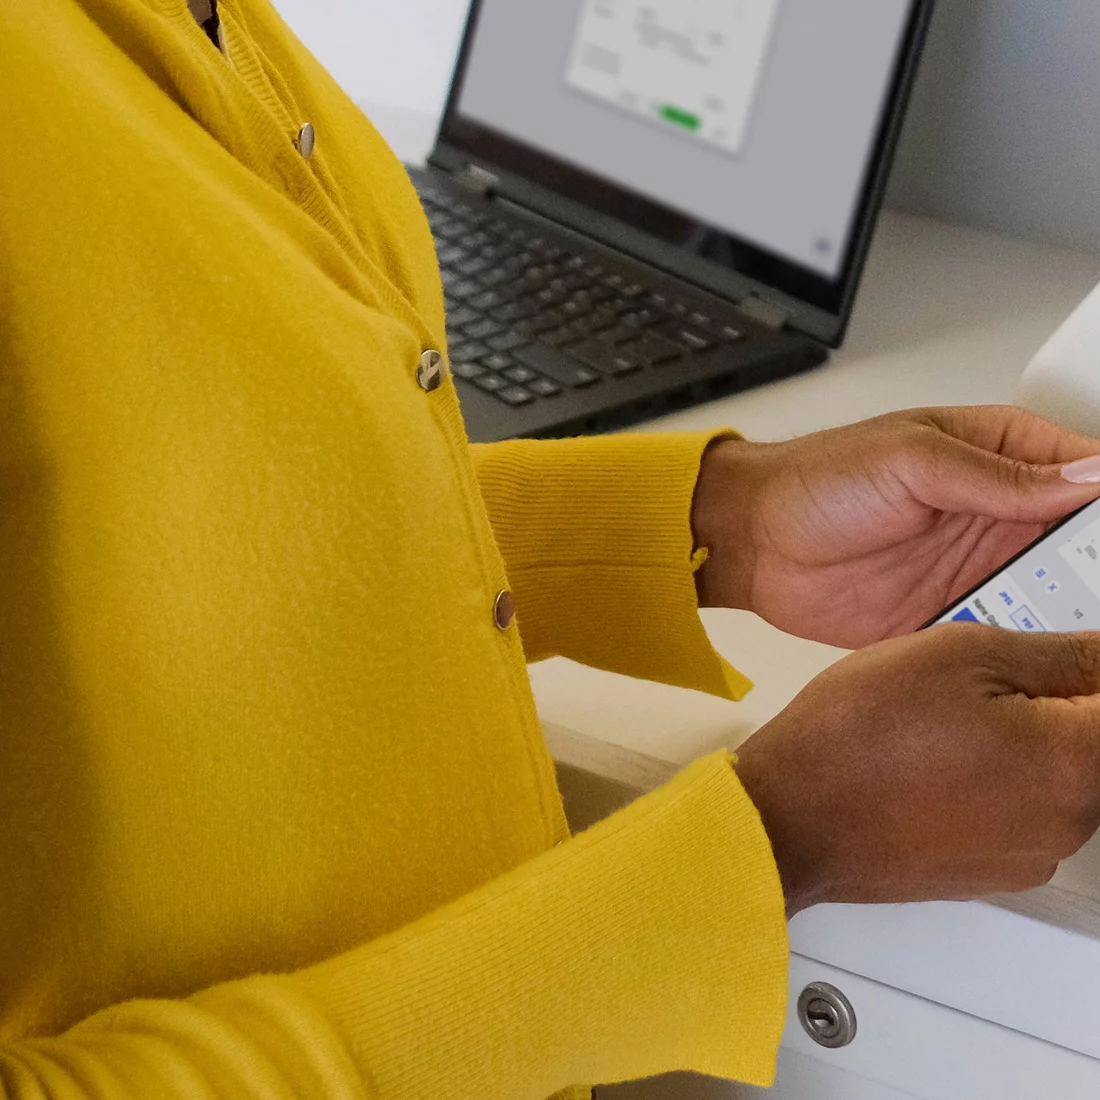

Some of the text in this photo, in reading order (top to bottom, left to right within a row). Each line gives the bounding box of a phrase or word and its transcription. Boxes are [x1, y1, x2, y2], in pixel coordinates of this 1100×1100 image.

[999, 591, 1014, 606] JPEG
[973, 598, 988, 616] Name
[1022, 617, 1034, 629] PDF
